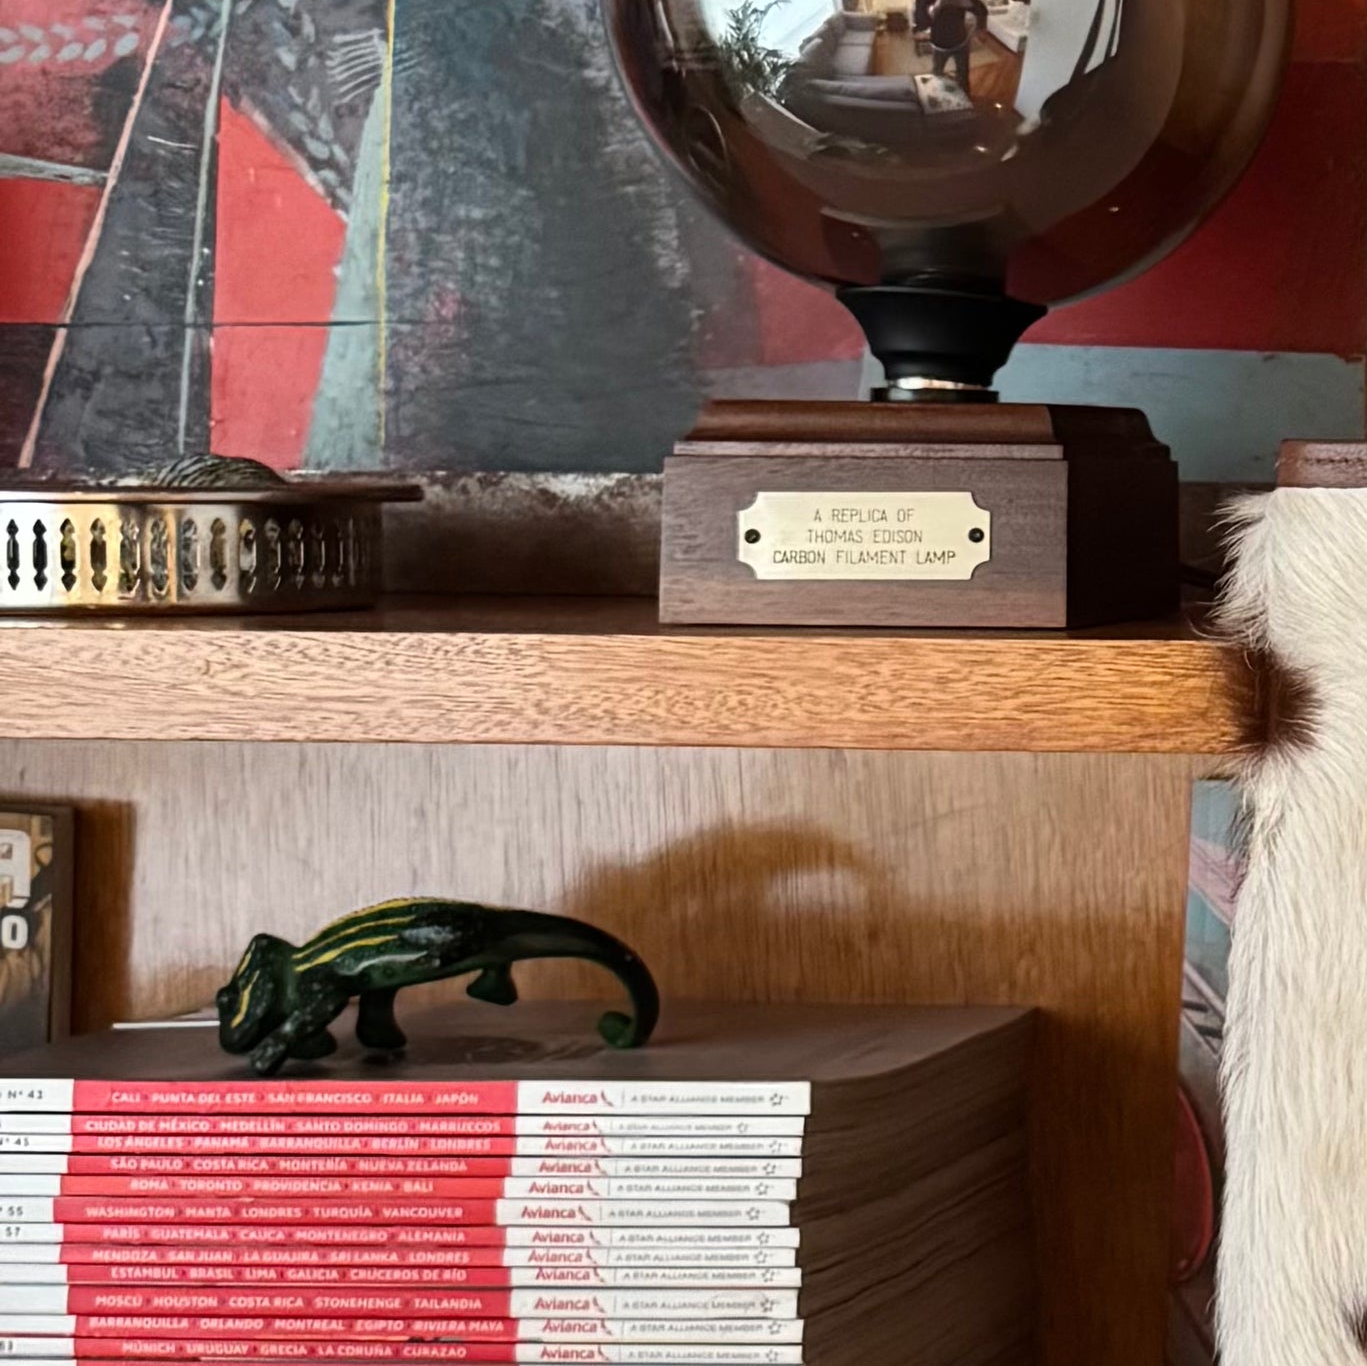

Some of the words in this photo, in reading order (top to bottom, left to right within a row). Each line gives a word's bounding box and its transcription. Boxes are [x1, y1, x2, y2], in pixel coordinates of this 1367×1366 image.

[814, 509, 822, 523] A
[832, 509, 888, 523] REPLICA
[897, 509, 914, 522] OF
[807, 529, 863, 544] THOMAS
[873, 529, 923, 544] EDISON
[773, 551, 826, 565] CARBON
[836, 550, 906, 565] FILAMENT
[916, 550, 956, 565] LAMP
[112, 1093, 140, 1103] CALI
[152, 1093, 195, 1103] PUNTA
[226, 1093, 255, 1103] ESTE
[268, 1092, 295, 1103] SAN
[297, 1092, 372, 1104] FRANCISCO
[384, 1093, 424, 1104] ITALIA
[542, 1091, 598, 1104] Avianca
